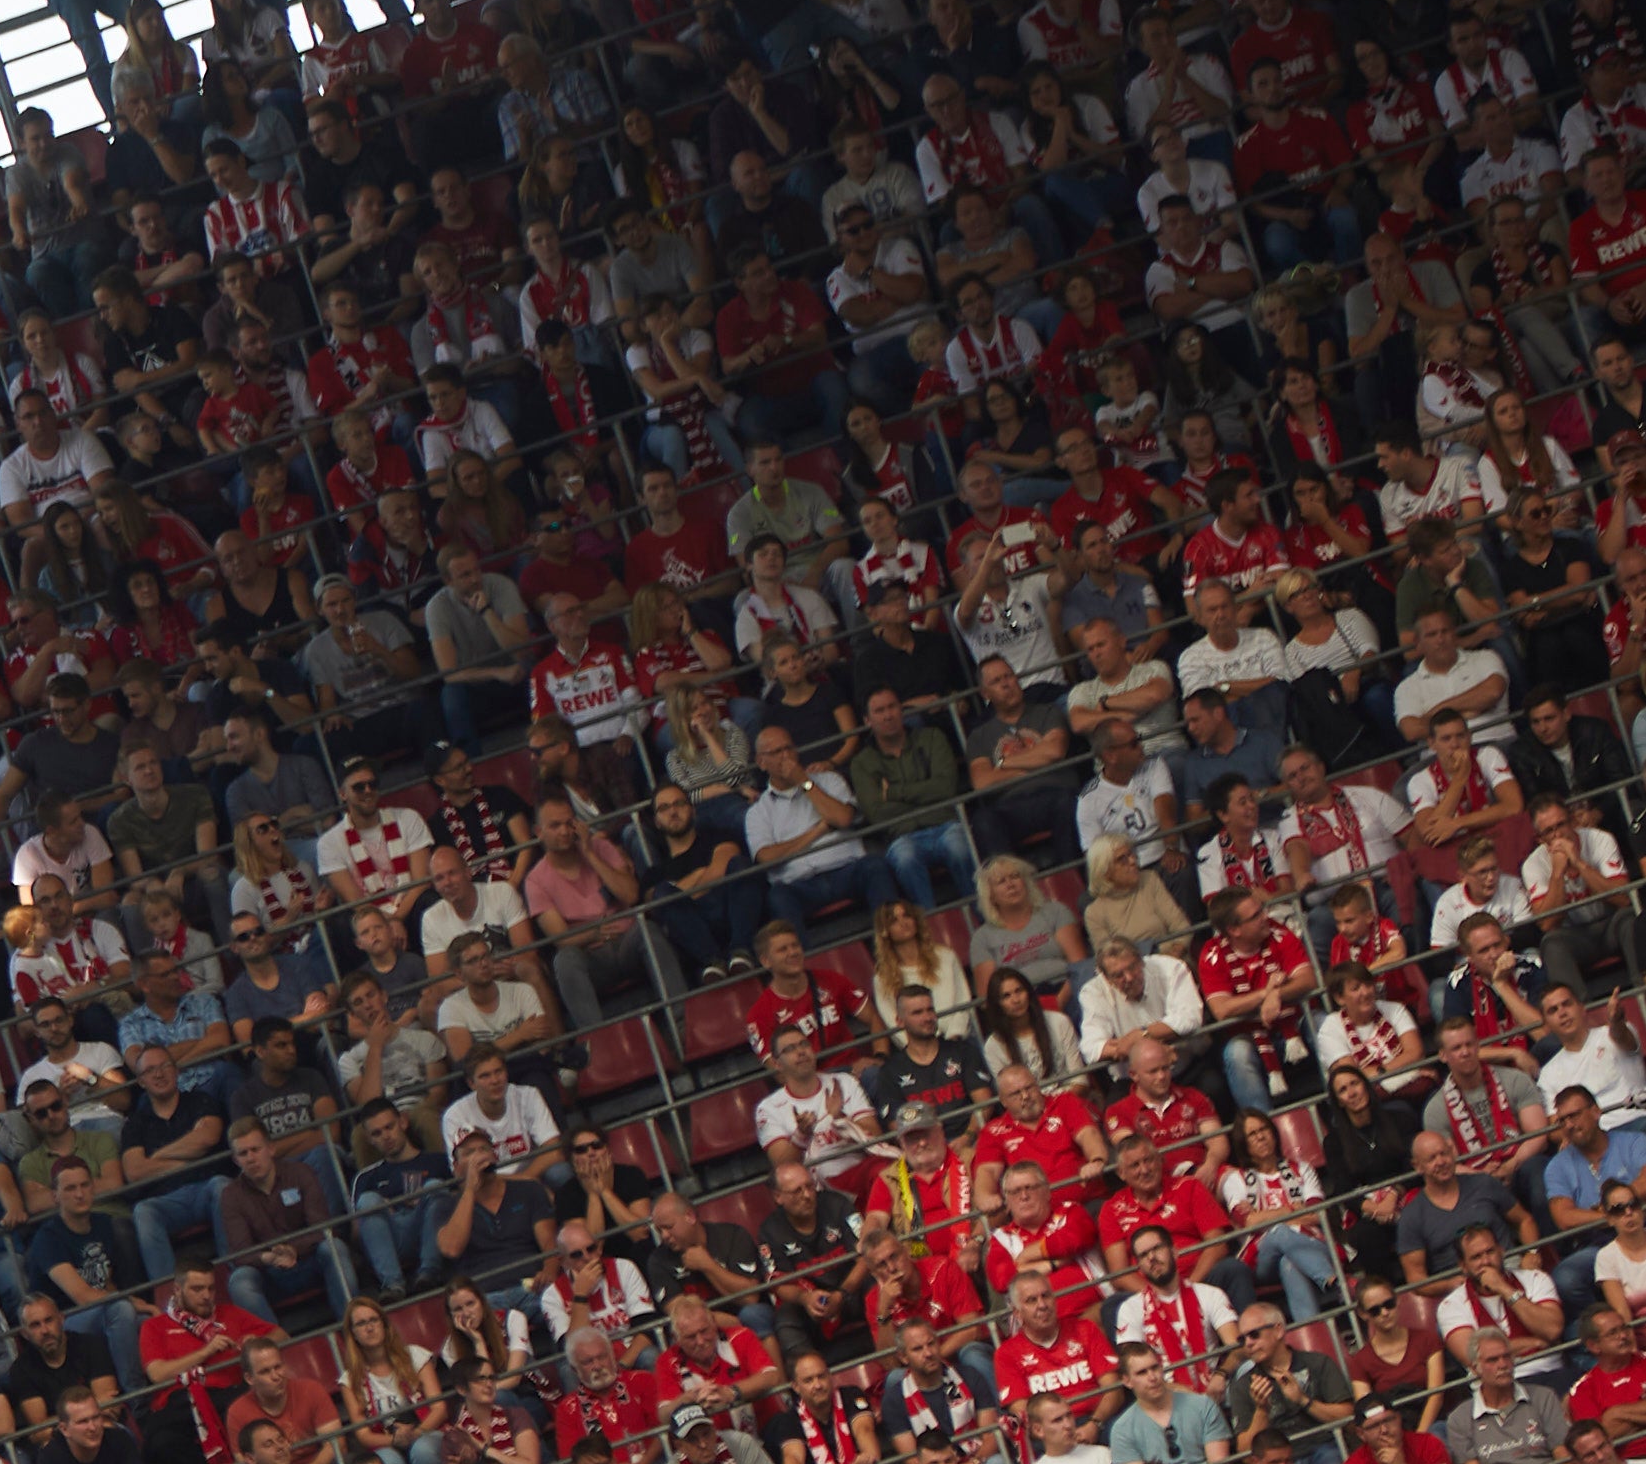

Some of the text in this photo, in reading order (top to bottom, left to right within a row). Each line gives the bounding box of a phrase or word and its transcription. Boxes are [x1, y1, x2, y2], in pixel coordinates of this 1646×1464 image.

[1280, 53, 1316, 81] EWE
[560, 688, 619, 716] REWE
[1029, 1360, 1092, 1395] REWE
